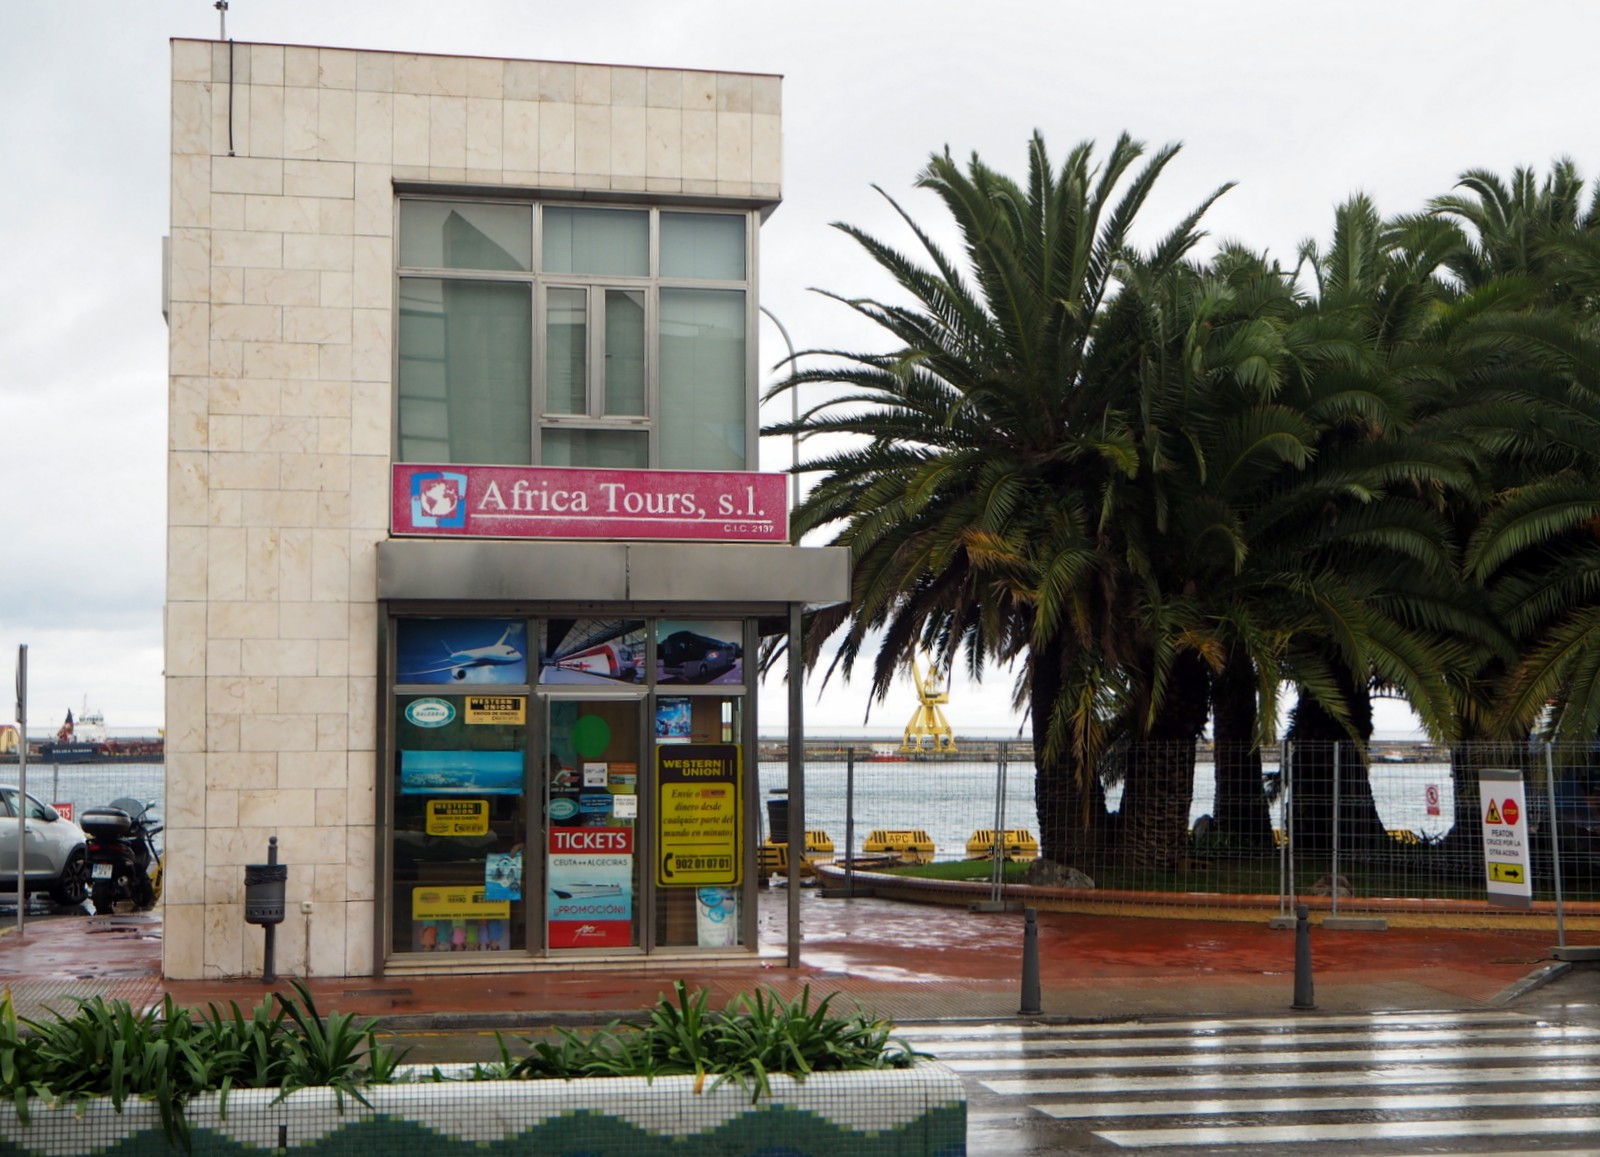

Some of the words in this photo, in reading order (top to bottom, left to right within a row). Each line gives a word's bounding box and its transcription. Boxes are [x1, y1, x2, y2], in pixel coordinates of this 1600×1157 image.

[478, 479, 589, 512] Africa
[600, 483, 706, 520] Tours,
[718, 486, 765, 516] s.l.
[723, 524, 749, 533] C.I.C.
[751, 524, 774, 533] 2137
[663, 760, 721, 768] WESTERN
[682, 768, 721, 776] UNION
[675, 802, 699, 811] dinero
[701, 802, 722, 811] desde
[663, 815, 700, 826] cualquier
[700, 816, 721, 826] parte
[722, 815, 734, 824] del
[663, 828, 690, 837] mundo
[702, 828, 733, 837] minutos
[1491, 829, 1514, 838] PEATON
[553, 832, 627, 849] TICKETS
[889, 834, 909, 843] APC
[1486, 838, 1502, 846] CRUCE
[1489, 848, 1501, 856] OTRA
[1502, 849, 1519, 857] ACERA
[676, 858, 693, 869] 902
[695, 858, 705, 869] 01
[707, 858, 717, 869] 07
[719, 858, 729, 869] 01
